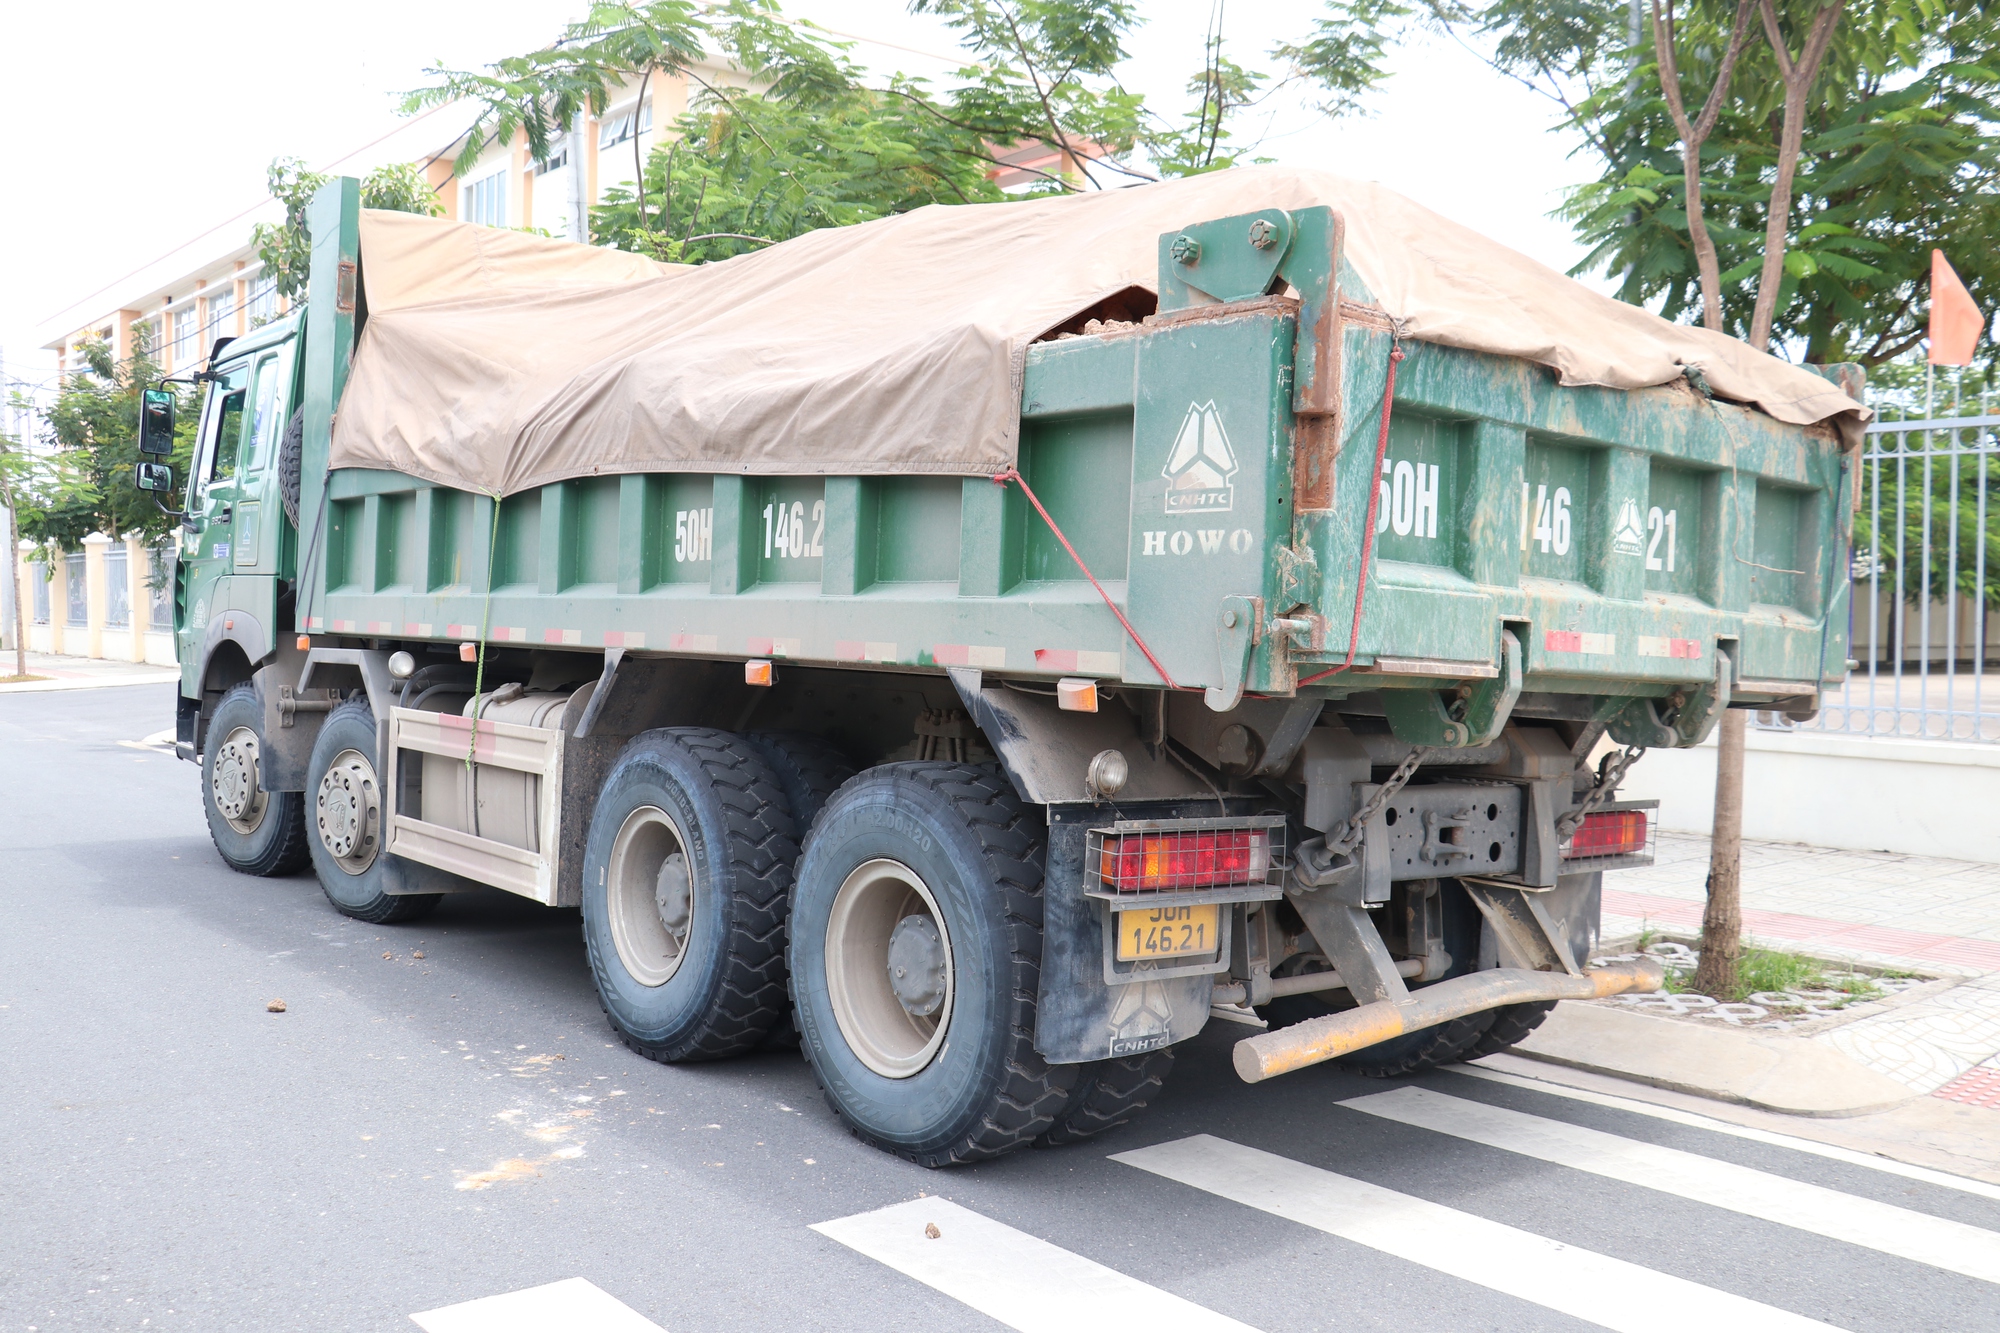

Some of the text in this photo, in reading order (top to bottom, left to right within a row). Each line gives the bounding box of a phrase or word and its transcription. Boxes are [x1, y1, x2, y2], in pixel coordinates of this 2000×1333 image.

[1169, 493, 1227, 506] CNHTC
[675, 507, 713, 563] 50H
[1142, 528, 1253, 556] HOWO
[1646, 506, 1677, 572] 21
[1134, 923, 1204, 954] 146.21
[1113, 1036, 1167, 1053] CNHTC
